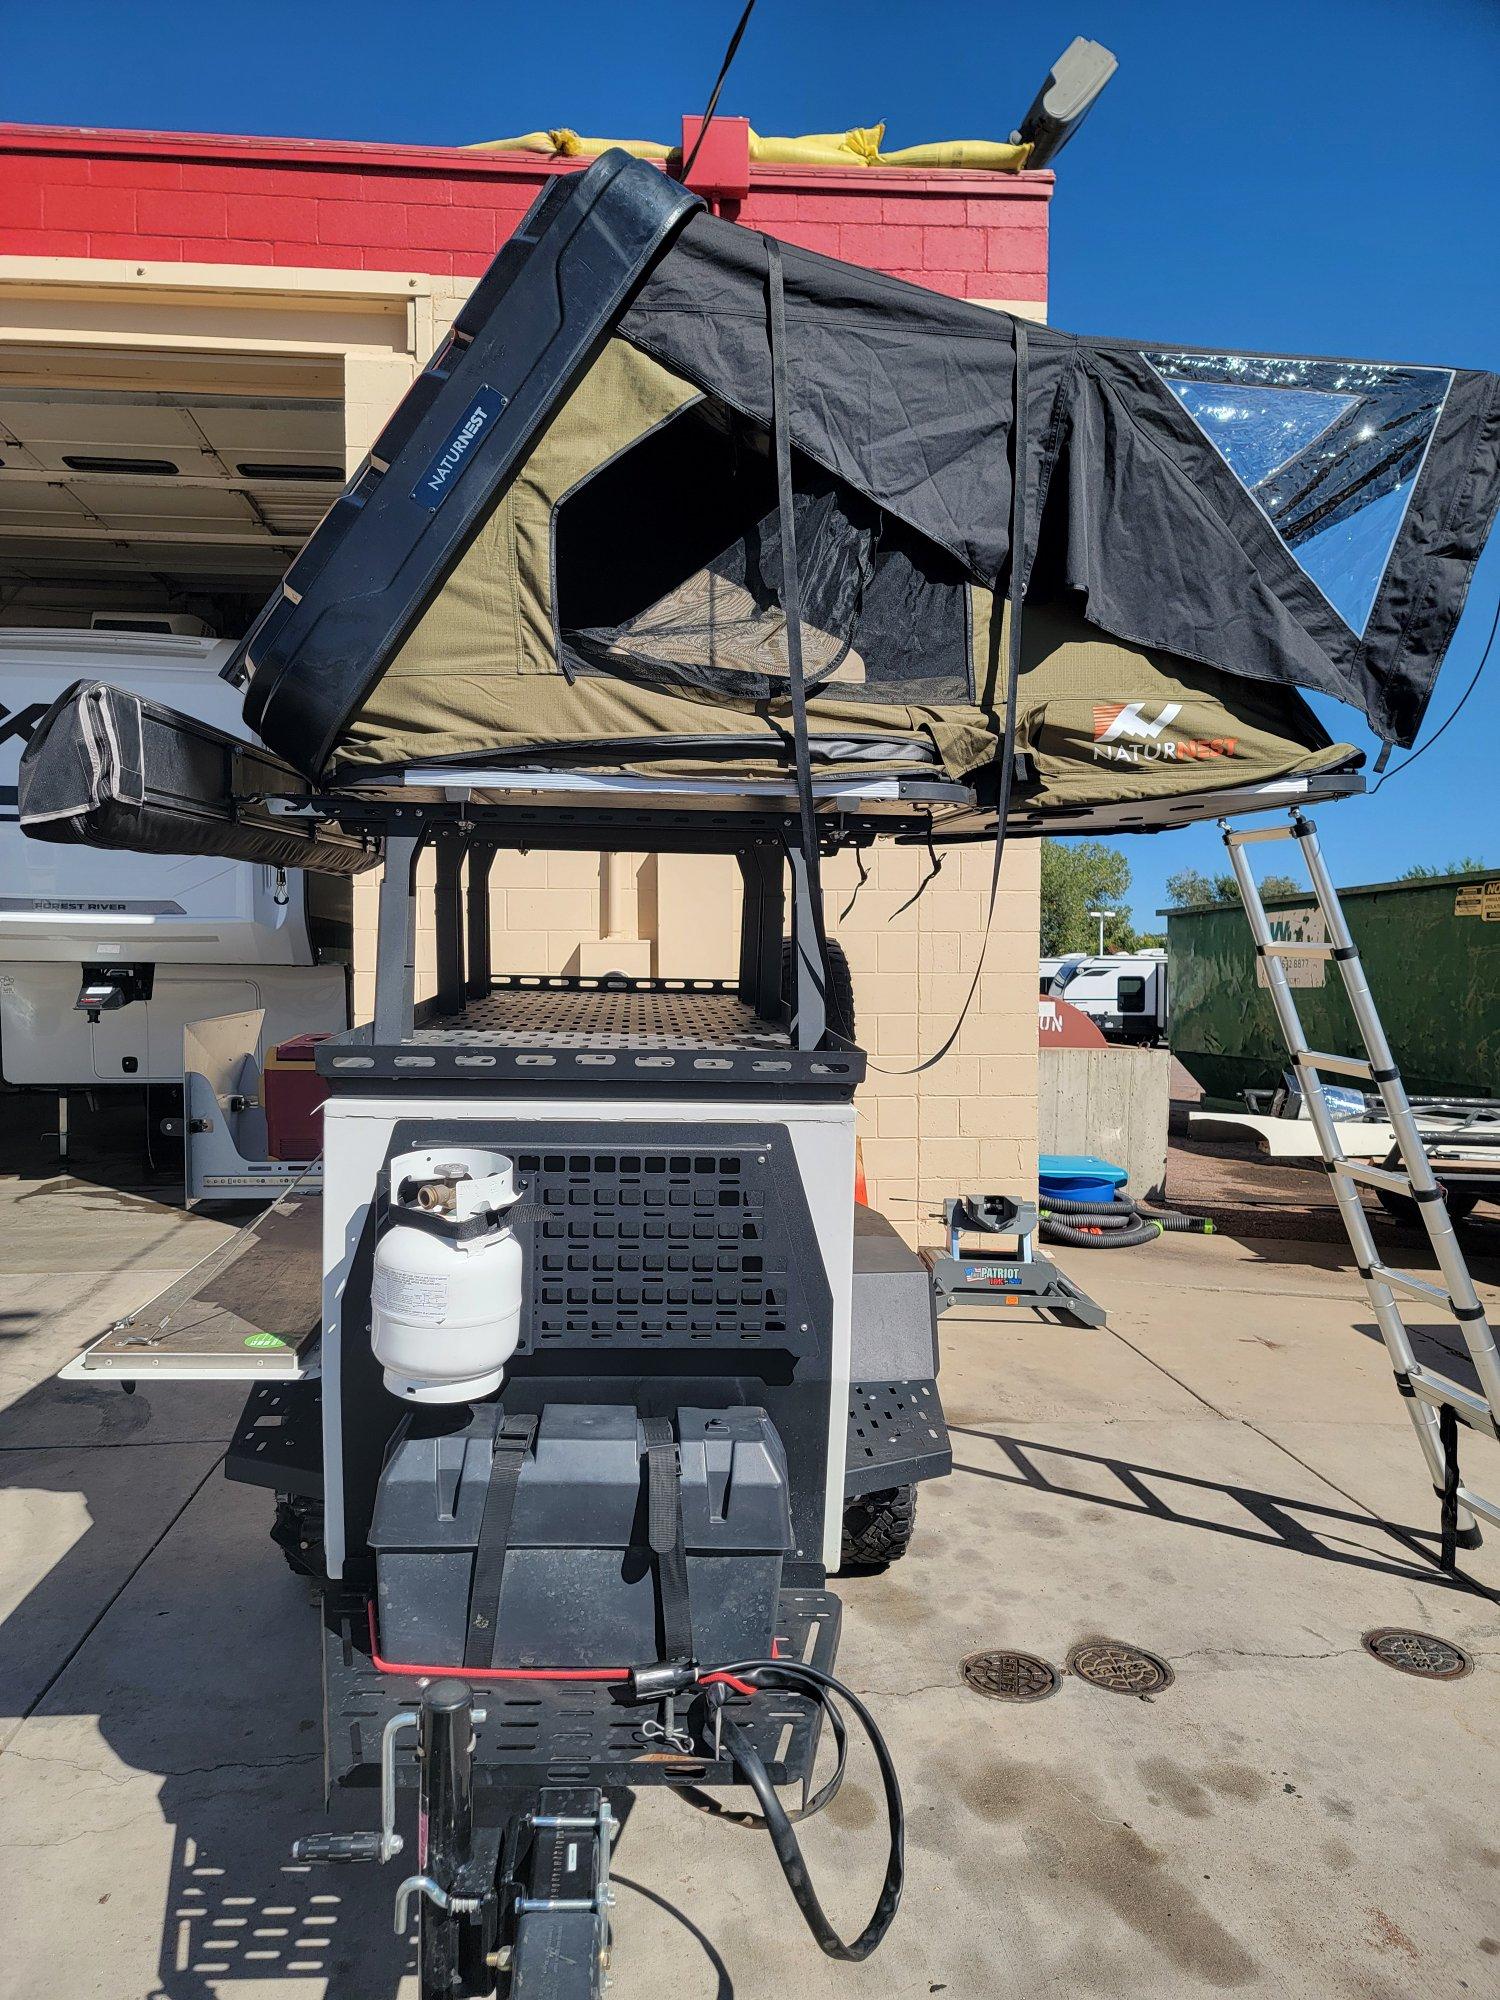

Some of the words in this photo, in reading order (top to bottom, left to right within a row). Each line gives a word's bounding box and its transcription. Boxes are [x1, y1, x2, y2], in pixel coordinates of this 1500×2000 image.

[427, 406, 488, 491] NATURNEST
[1093, 737, 1239, 762] NATURNEST
[34, 902, 84, 911] FOREST
[87, 903, 127, 911] RIVER
[981, 1266, 1020, 1279] PATRIOT
